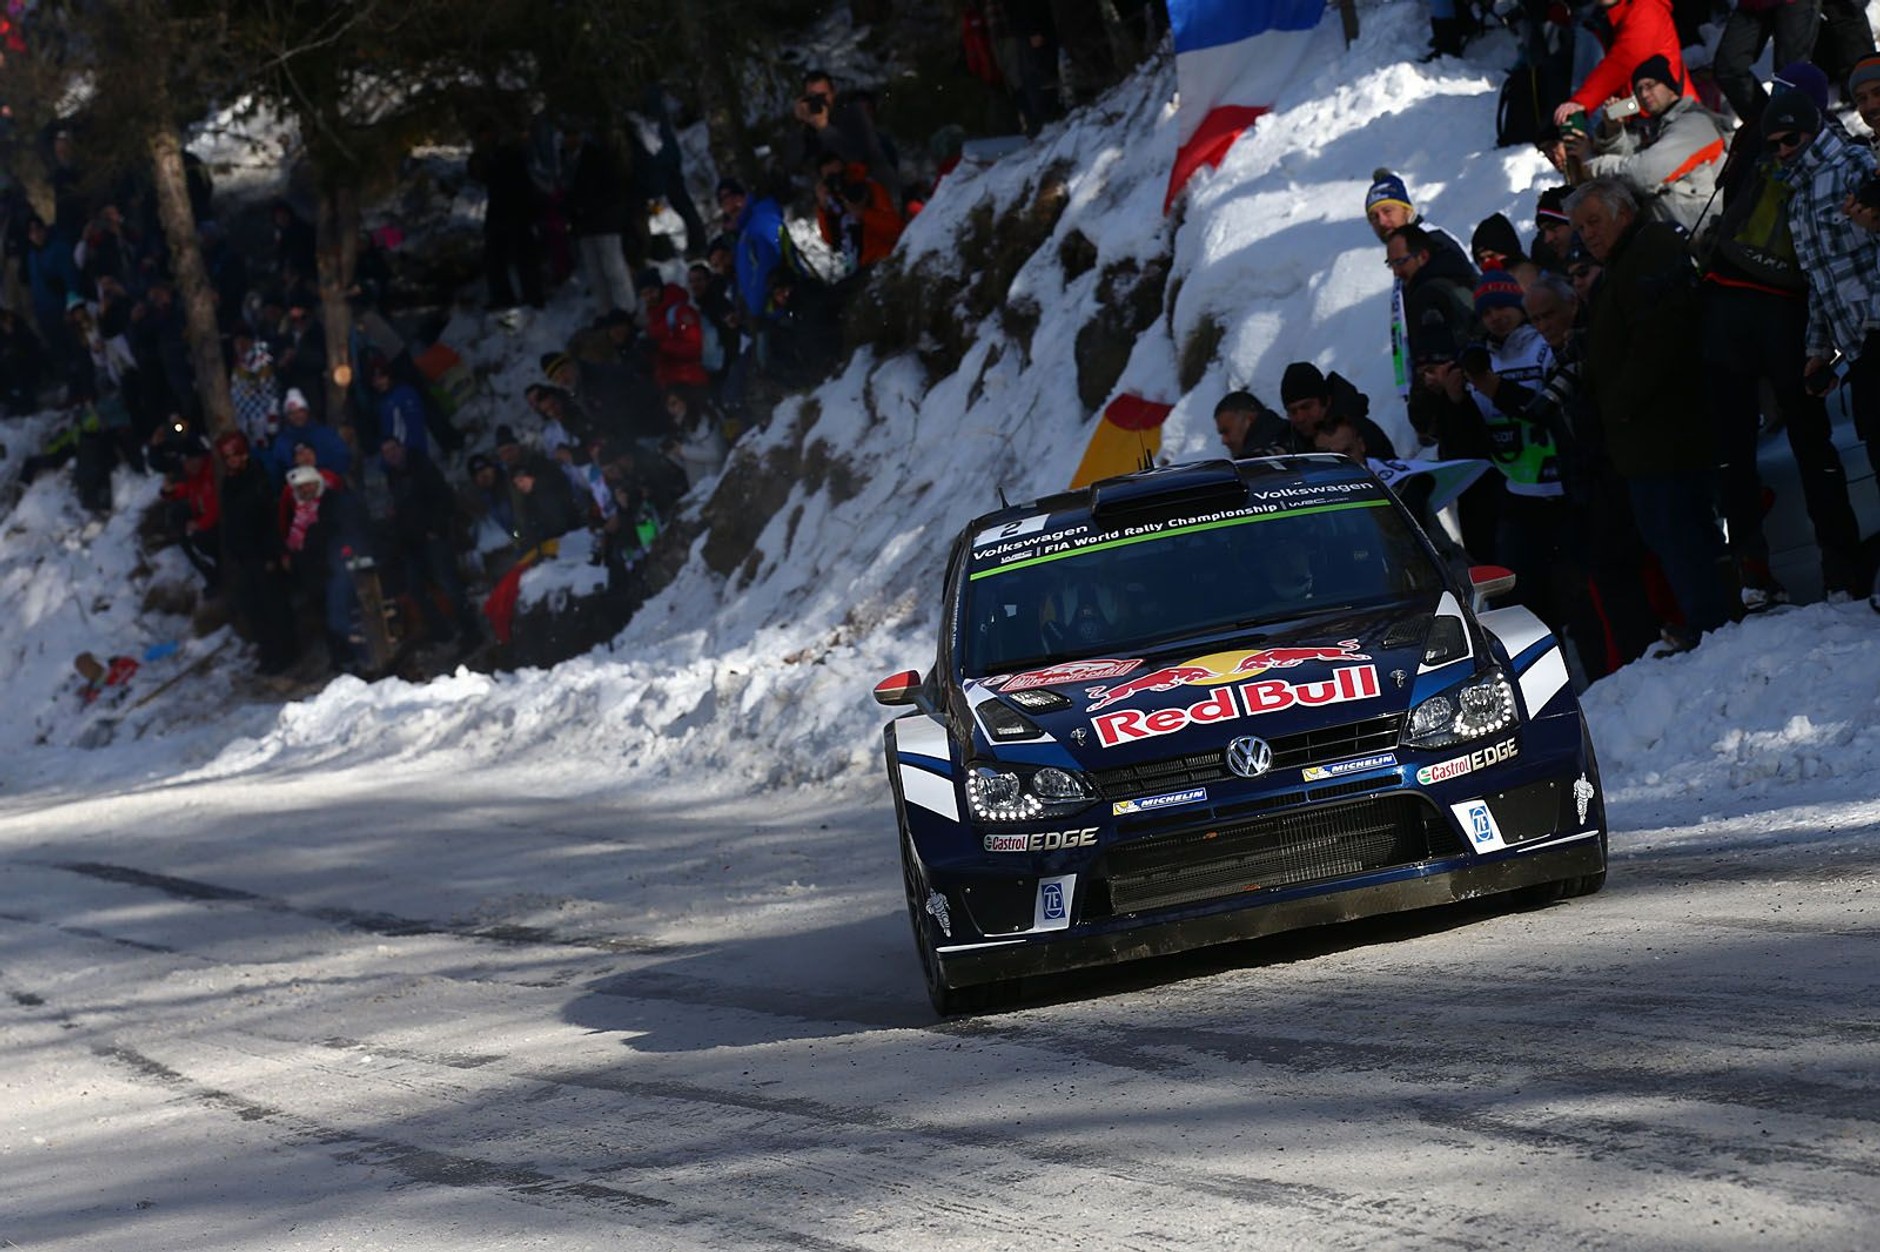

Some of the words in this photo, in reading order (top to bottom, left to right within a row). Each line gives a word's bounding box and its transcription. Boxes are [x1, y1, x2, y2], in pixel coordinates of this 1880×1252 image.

[1254, 481, 1374, 500] Volkswagen
[1001, 521, 1023, 538] 2
[1044, 542, 1071, 555] FIA
[1074, 531, 1120, 546] World
[1124, 522, 1164, 536] Rally
[1168, 502, 1278, 528] Championship
[973, 525, 1089, 561] Volkswagen
[1092, 687, 1239, 747] Red
[1243, 665, 1379, 714] Bull
[1330, 755, 1393, 774] MICHELIN
[1431, 757, 1470, 782] Castrol
[1471, 737, 1519, 772] EDGE
[1140, 790, 1204, 808] MICHELIN
[992, 834, 1027, 851] Castrol
[1028, 827, 1100, 851] EDGE
